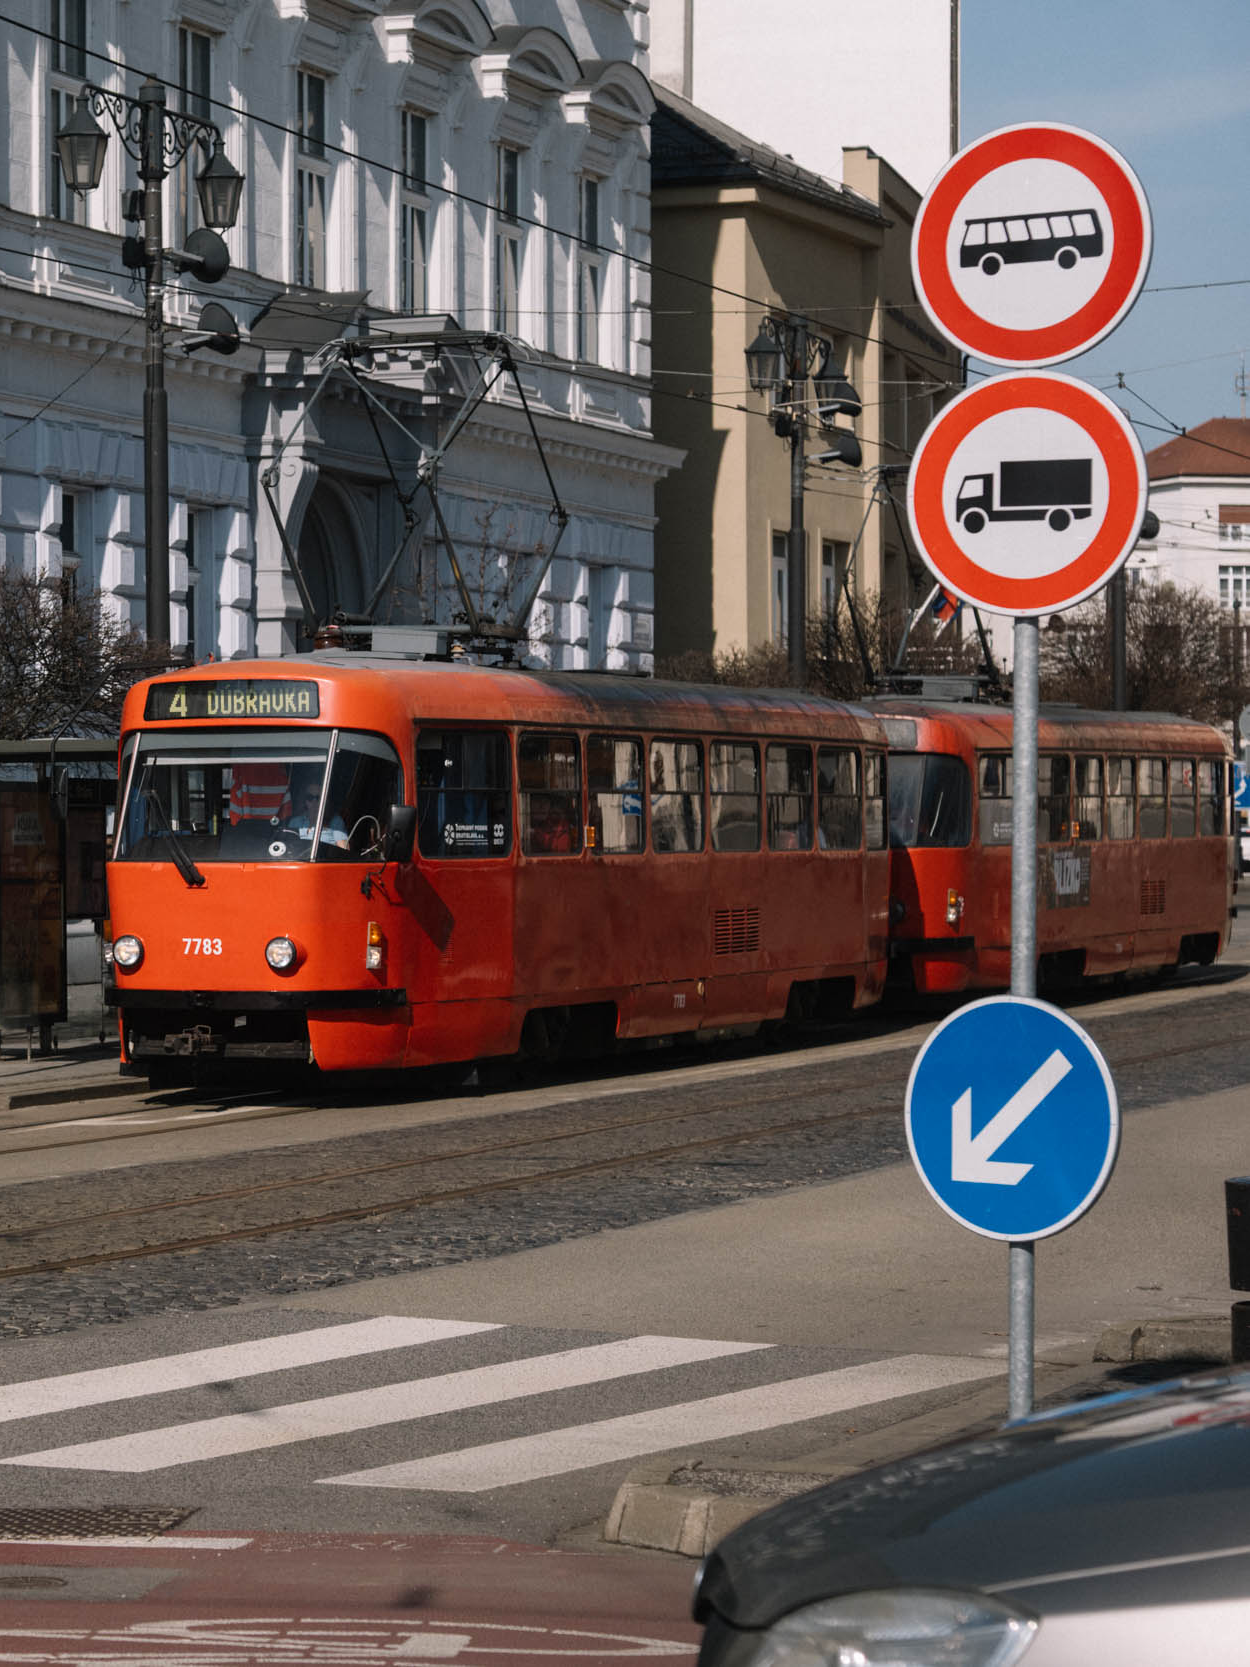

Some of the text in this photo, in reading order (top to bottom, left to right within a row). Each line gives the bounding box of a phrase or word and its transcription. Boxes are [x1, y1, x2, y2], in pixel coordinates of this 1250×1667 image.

[169, 684, 310, 717] 4 DÚBRAVKA
[182, 937, 223, 956] 7783
